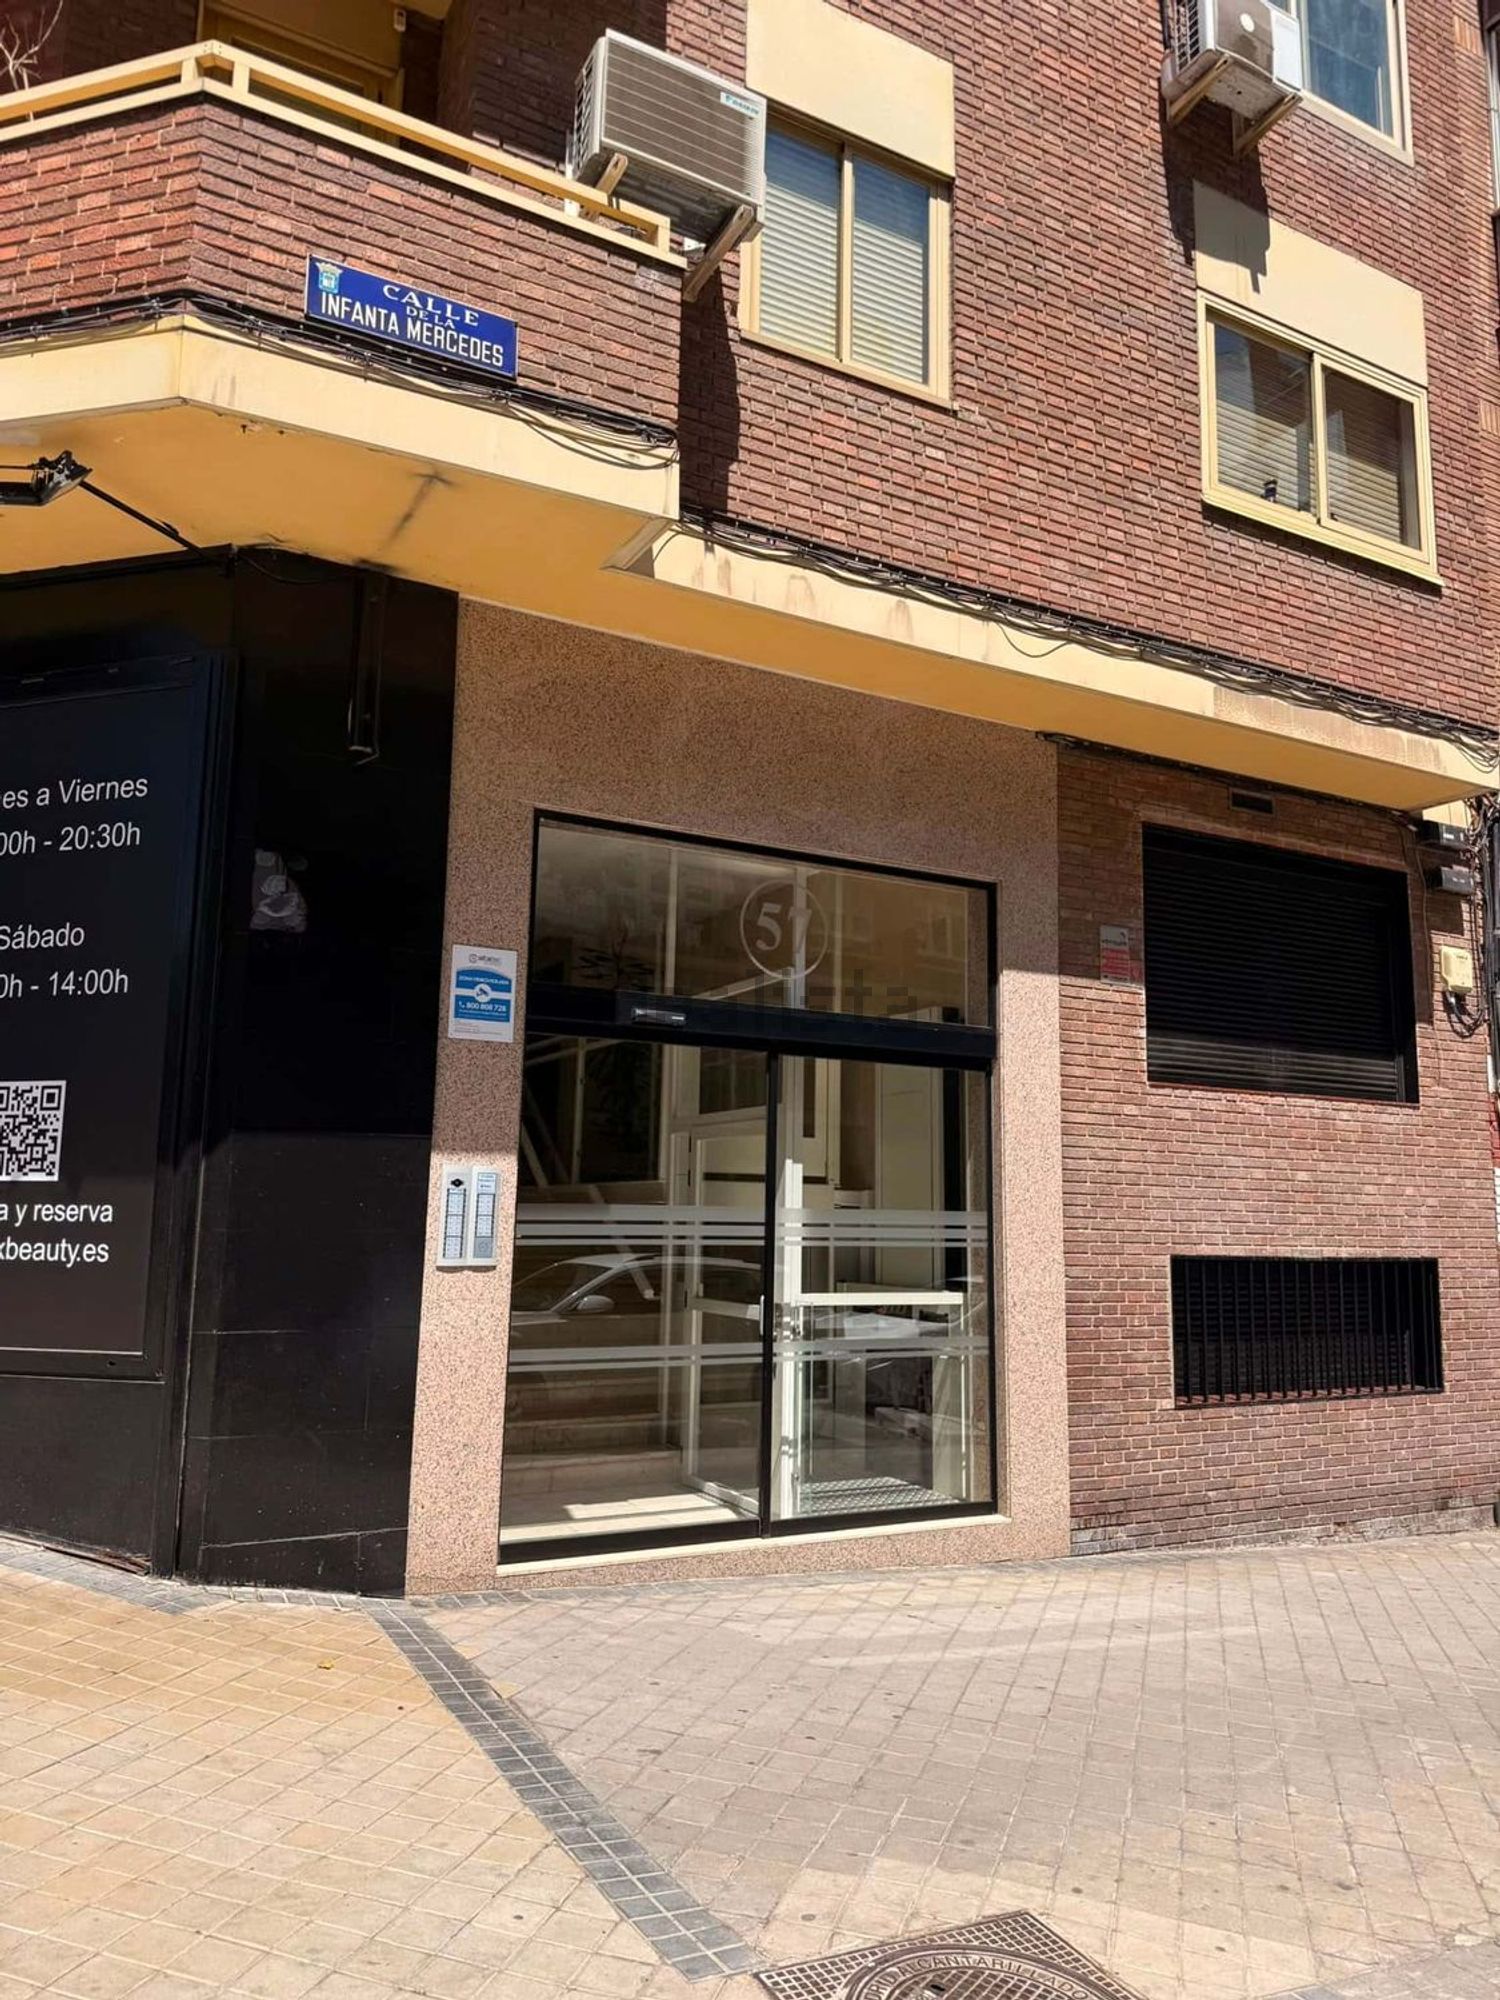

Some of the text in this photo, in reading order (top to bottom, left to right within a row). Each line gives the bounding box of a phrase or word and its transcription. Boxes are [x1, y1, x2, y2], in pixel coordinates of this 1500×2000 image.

[383, 284, 479, 326] CALLE
[405, 305, 456, 329] DE LA
[321, 291, 504, 368] INFANTA MERCEDES
[0, 777, 149, 809] es a Viernes
[59, 821, 141, 852] 20:30h
[0, 922, 85, 951] Sábado
[755, 902, 812, 954] 57
[49, 968, 129, 996] 14:00h
[14, 1203, 28, 1227] y
[33, 1203, 113, 1222] reserva
